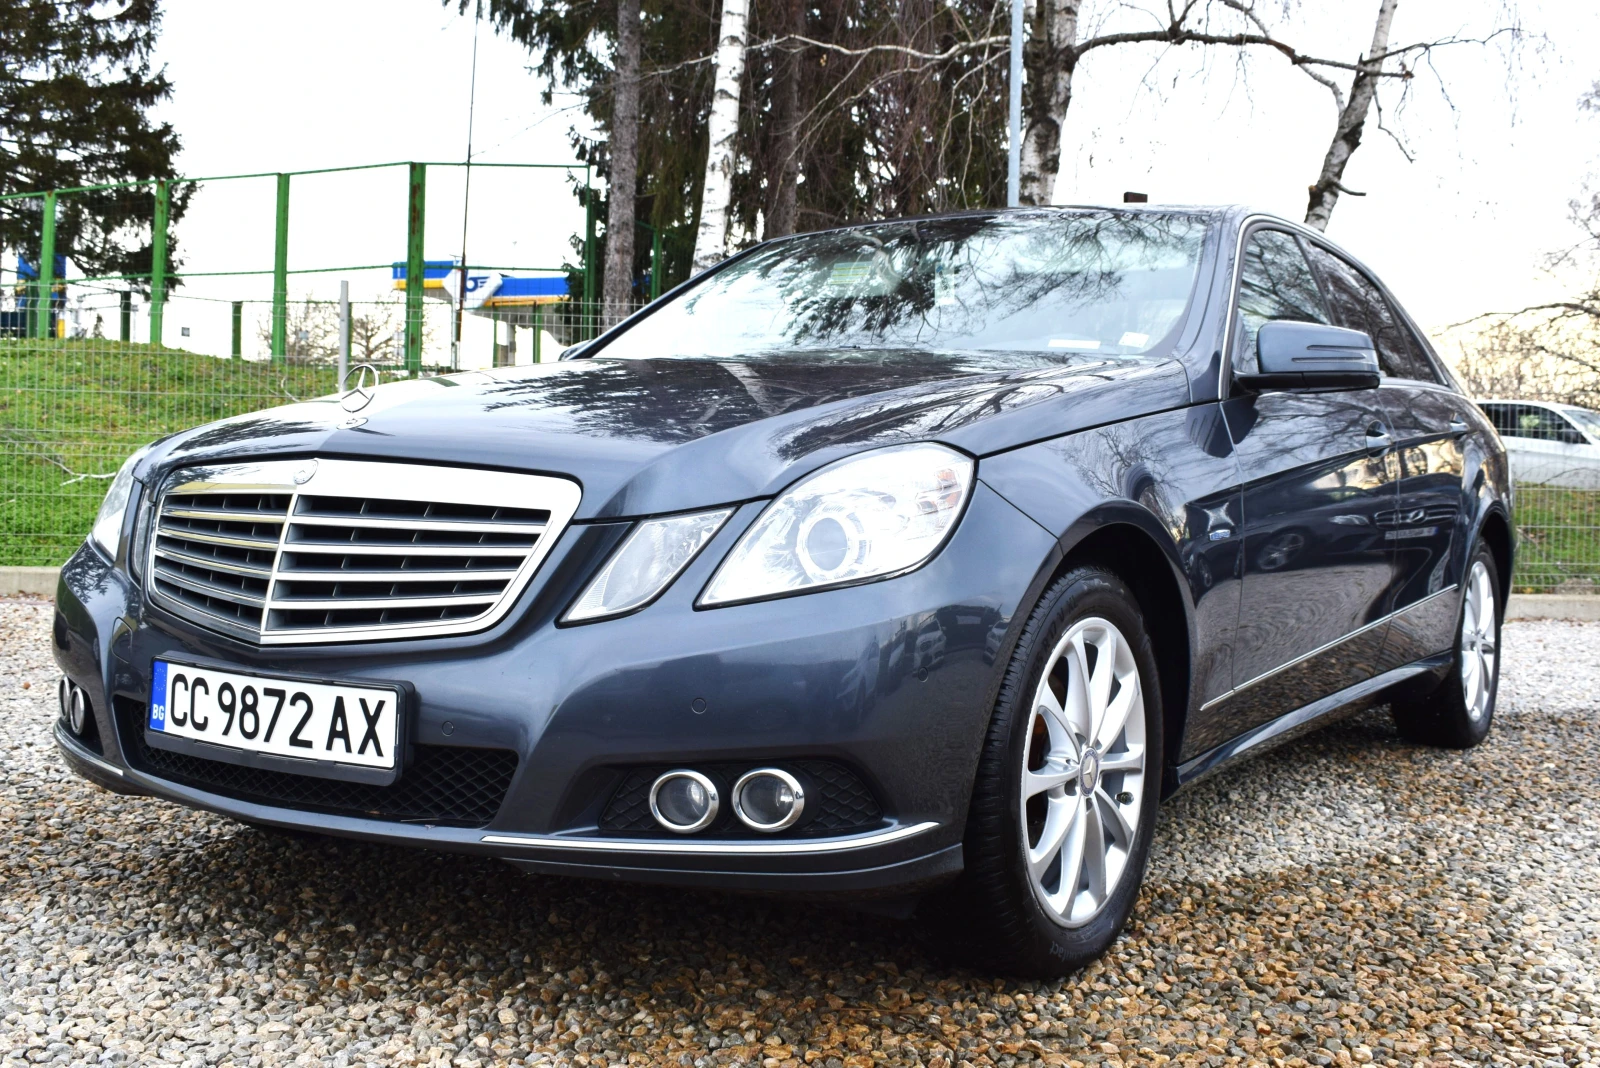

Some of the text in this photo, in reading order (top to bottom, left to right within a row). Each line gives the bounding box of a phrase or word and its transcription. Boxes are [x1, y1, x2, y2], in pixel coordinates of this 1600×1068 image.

[152, 703, 165, 721] BG
[171, 673, 386, 757] CC 9872 AX
